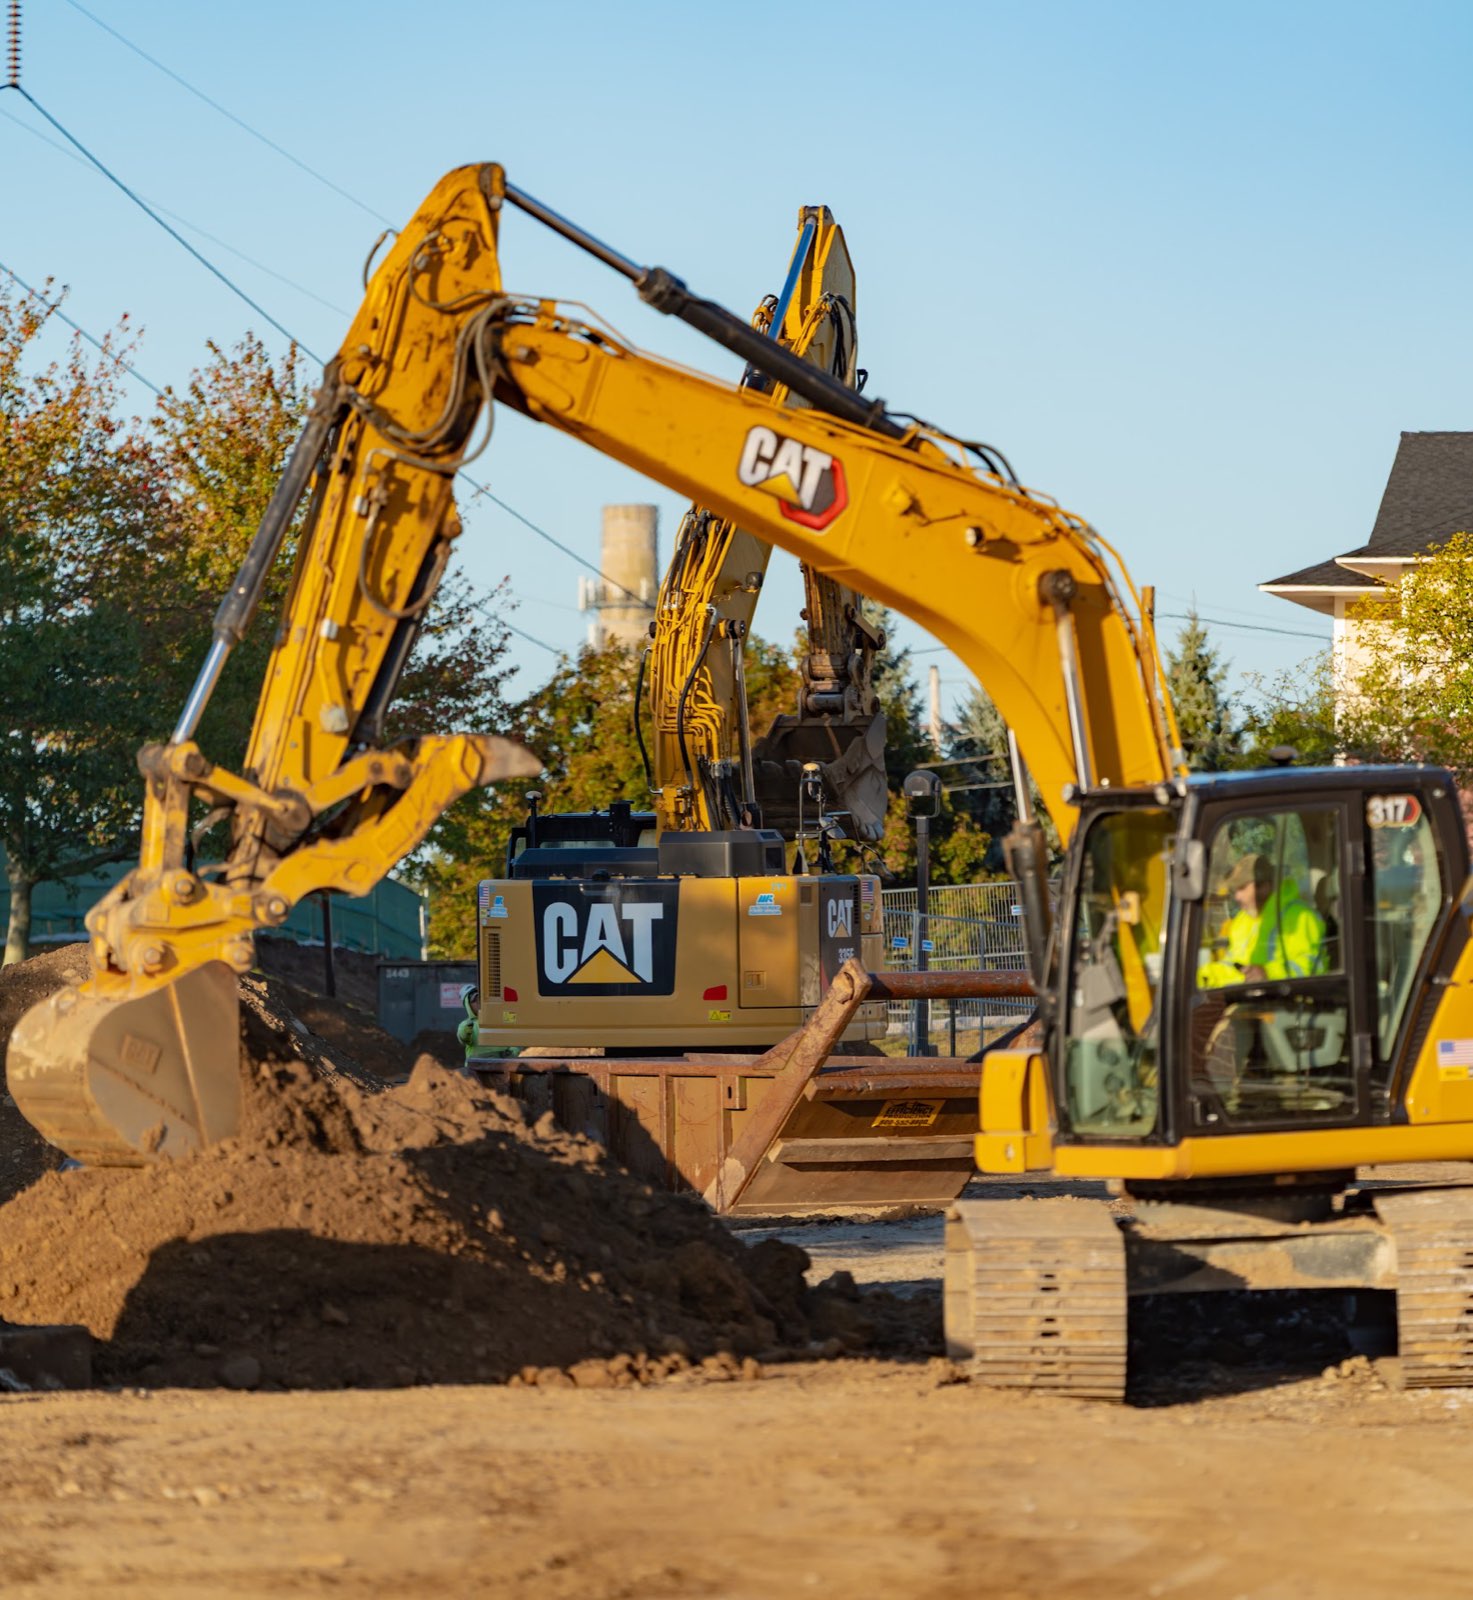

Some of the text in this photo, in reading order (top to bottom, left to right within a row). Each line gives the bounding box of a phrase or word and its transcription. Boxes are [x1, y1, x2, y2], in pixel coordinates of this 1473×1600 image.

[739, 425, 833, 510] CAT
[1368, 796, 1408, 823] 317
[543, 902, 664, 984] CAT
[828, 899, 853, 938] CAT
